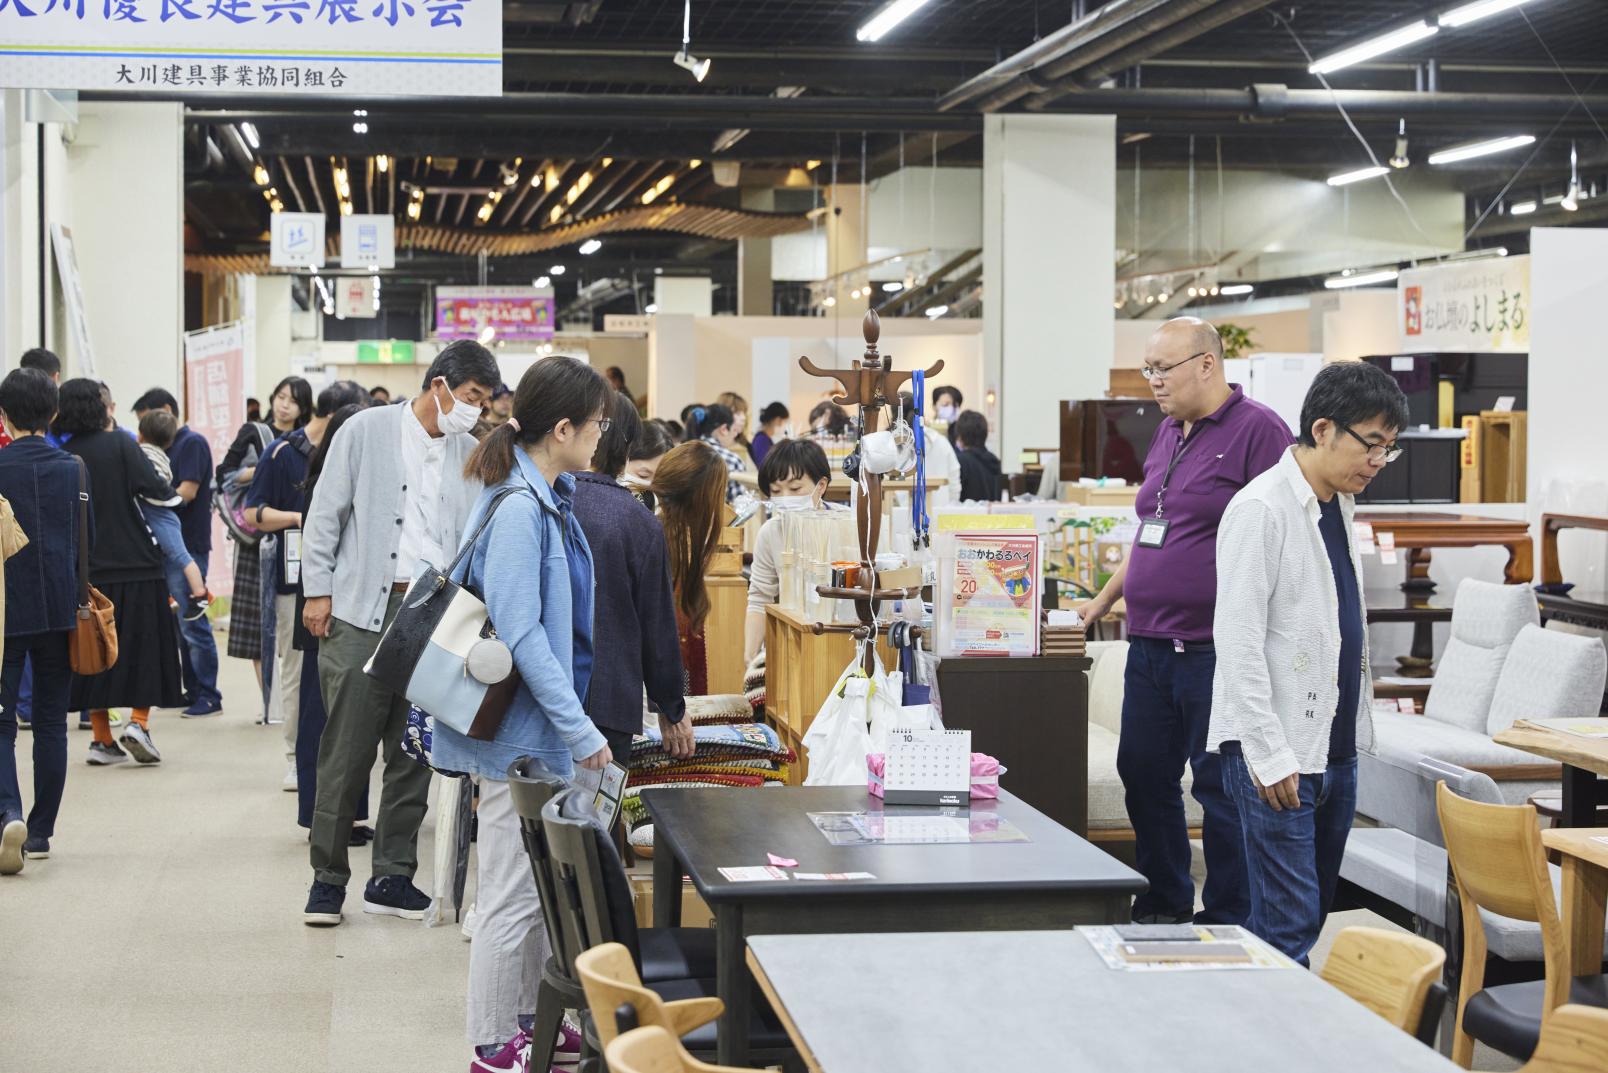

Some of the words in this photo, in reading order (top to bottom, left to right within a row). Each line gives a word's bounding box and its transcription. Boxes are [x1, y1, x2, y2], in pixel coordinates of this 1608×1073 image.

[115, 64, 349, 88] 大川建具事業協同組合
[960, 580, 977, 593] 20
